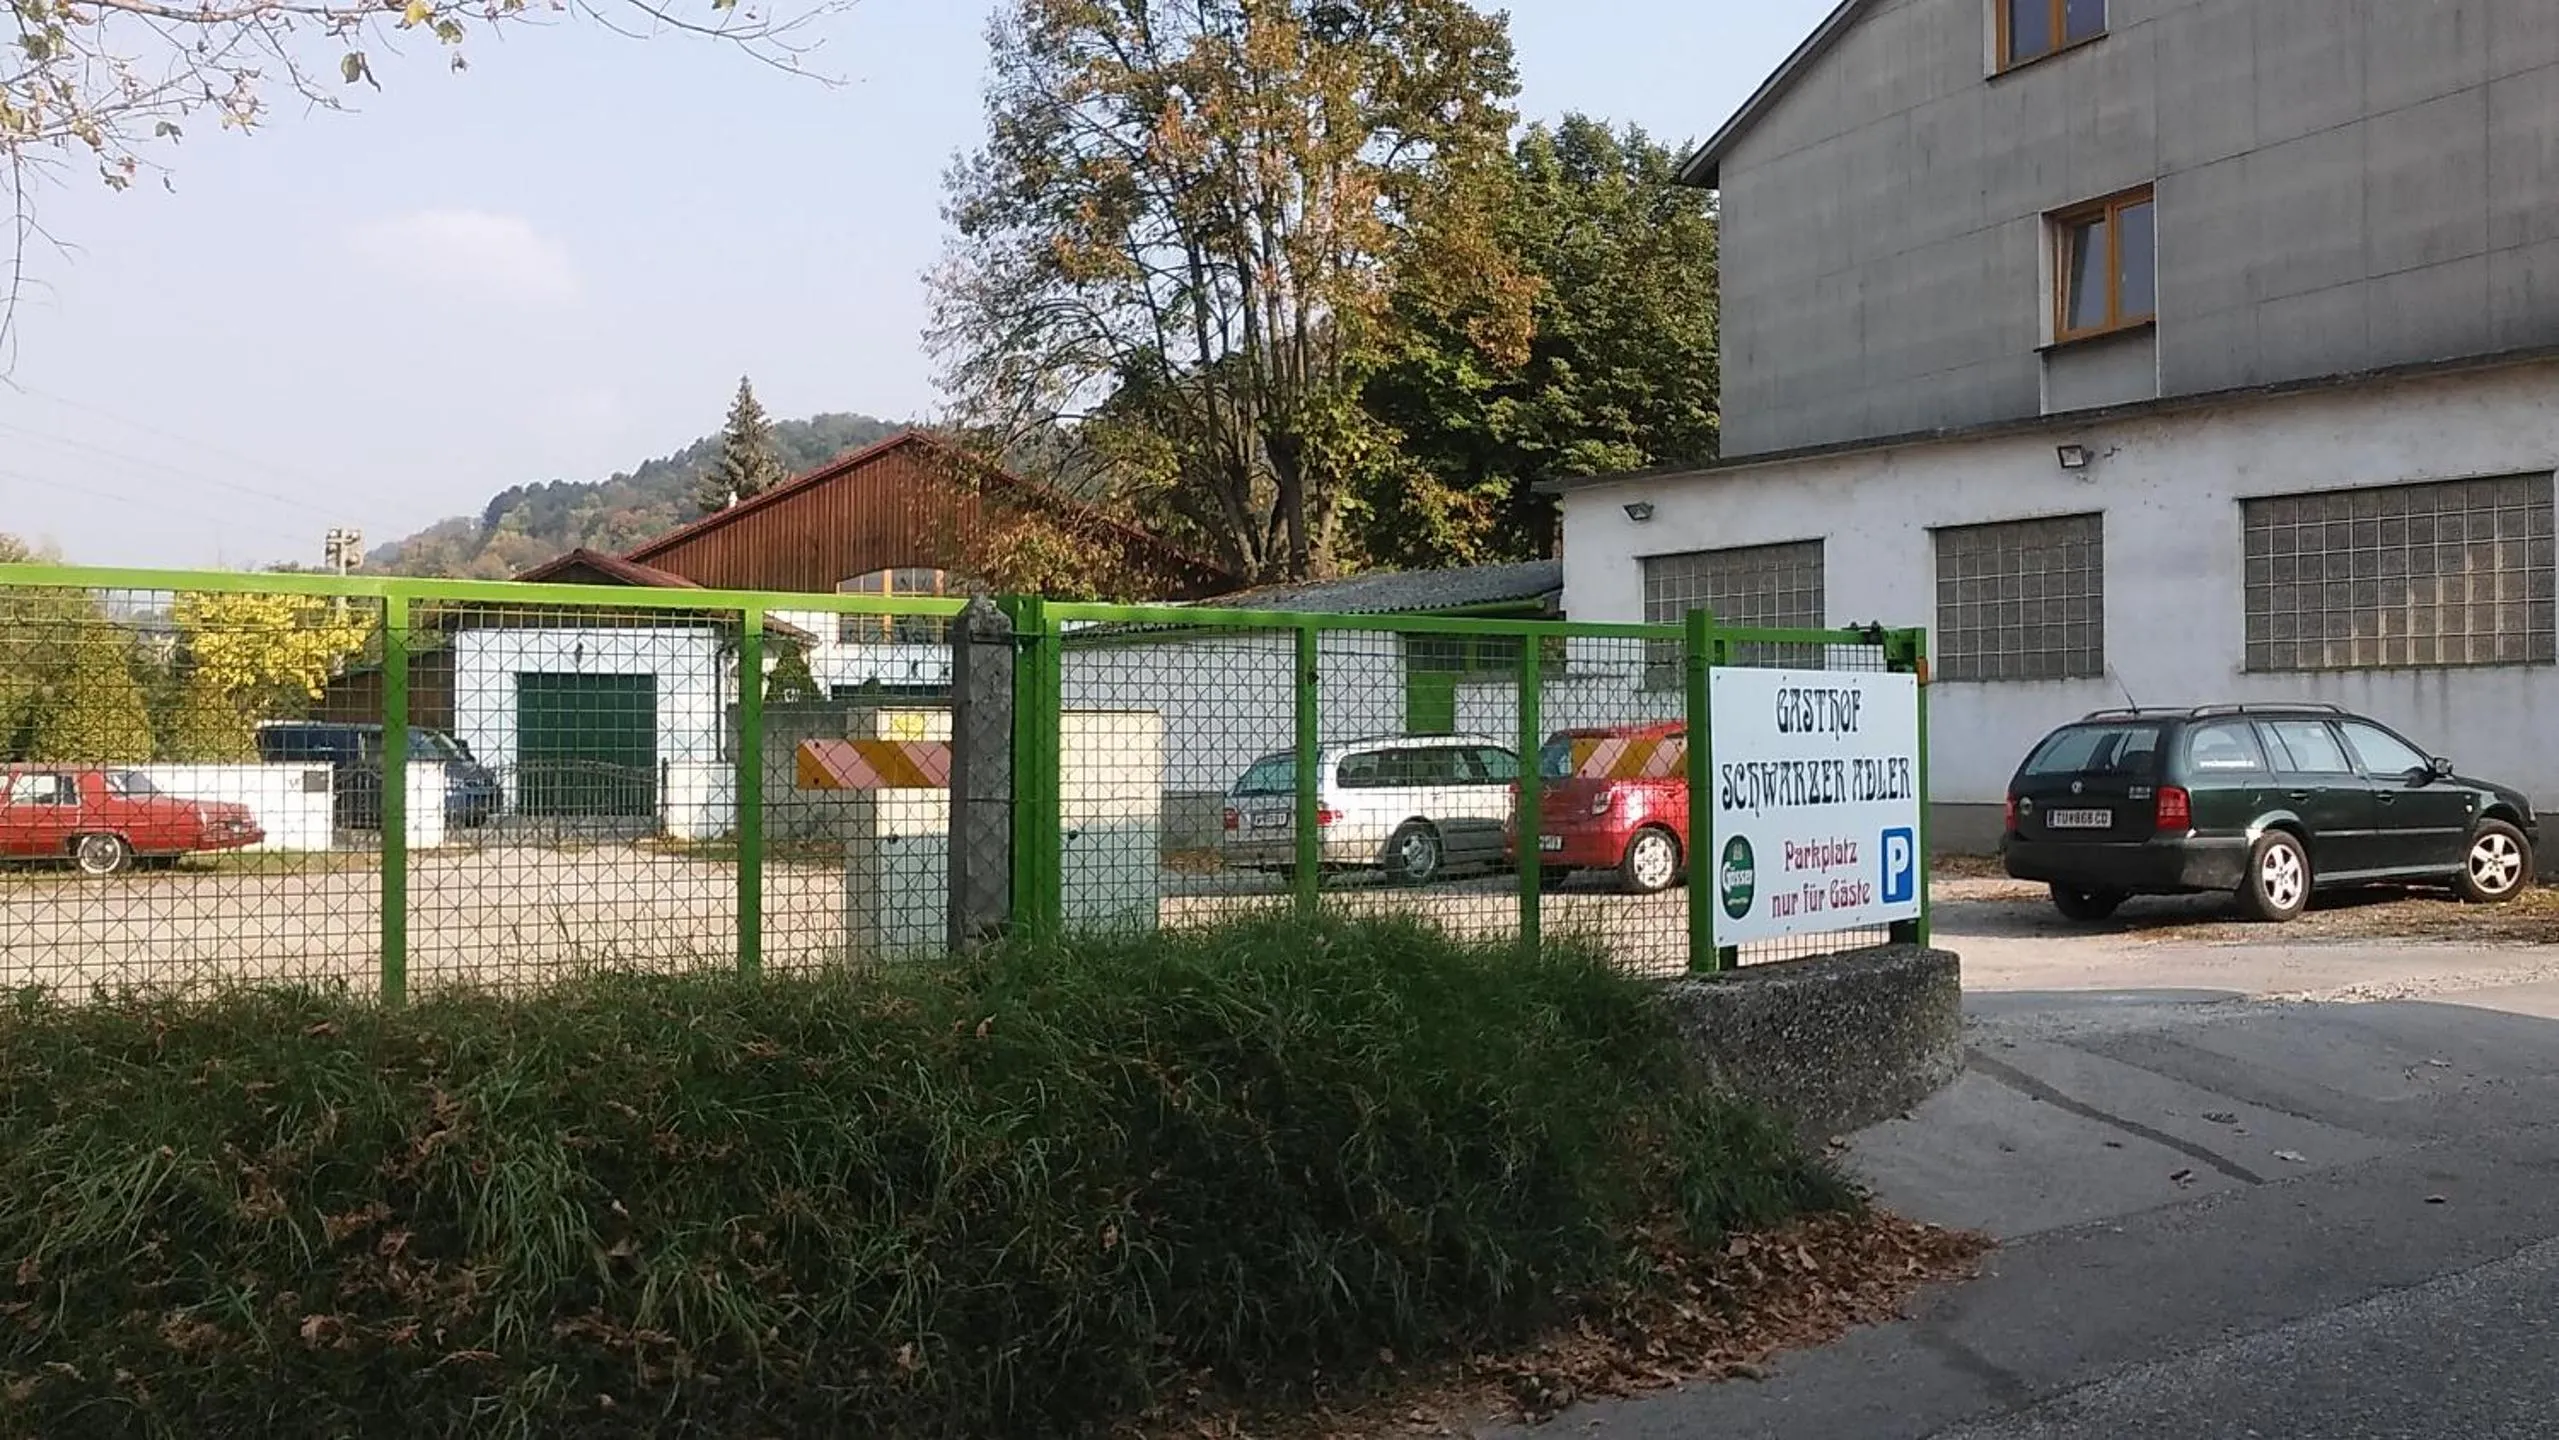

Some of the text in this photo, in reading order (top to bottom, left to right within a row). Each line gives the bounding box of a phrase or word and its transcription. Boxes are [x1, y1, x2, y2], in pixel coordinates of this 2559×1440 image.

[1776, 688, 1861, 741] GASTHOF
[1722, 757, 1911, 818] SCHWARZER ADLER
[1784, 836, 1858, 873] Parkplatz
[1887, 837, 1909, 895] P
[1772, 879, 1871, 918] nur für Gäste
